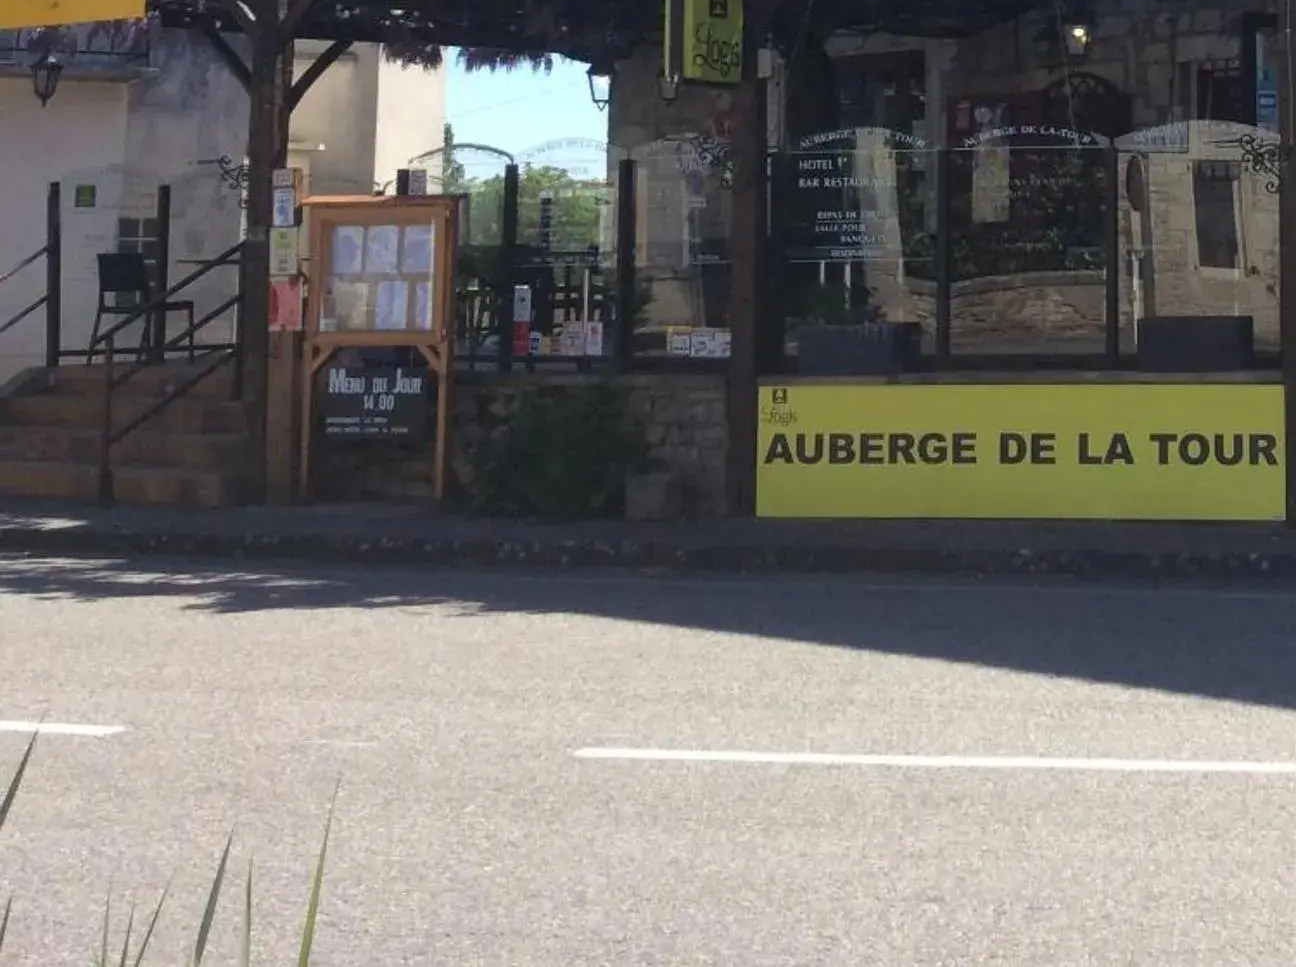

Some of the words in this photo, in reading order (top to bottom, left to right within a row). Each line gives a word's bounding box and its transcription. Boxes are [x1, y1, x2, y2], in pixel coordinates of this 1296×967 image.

[693, 19, 740, 79] Logis
[764, 432, 977, 464] AUBERGE
[999, 433, 1056, 464] DE
[1078, 433, 1134, 464] LA
[1149, 433, 1279, 465] TOUR
